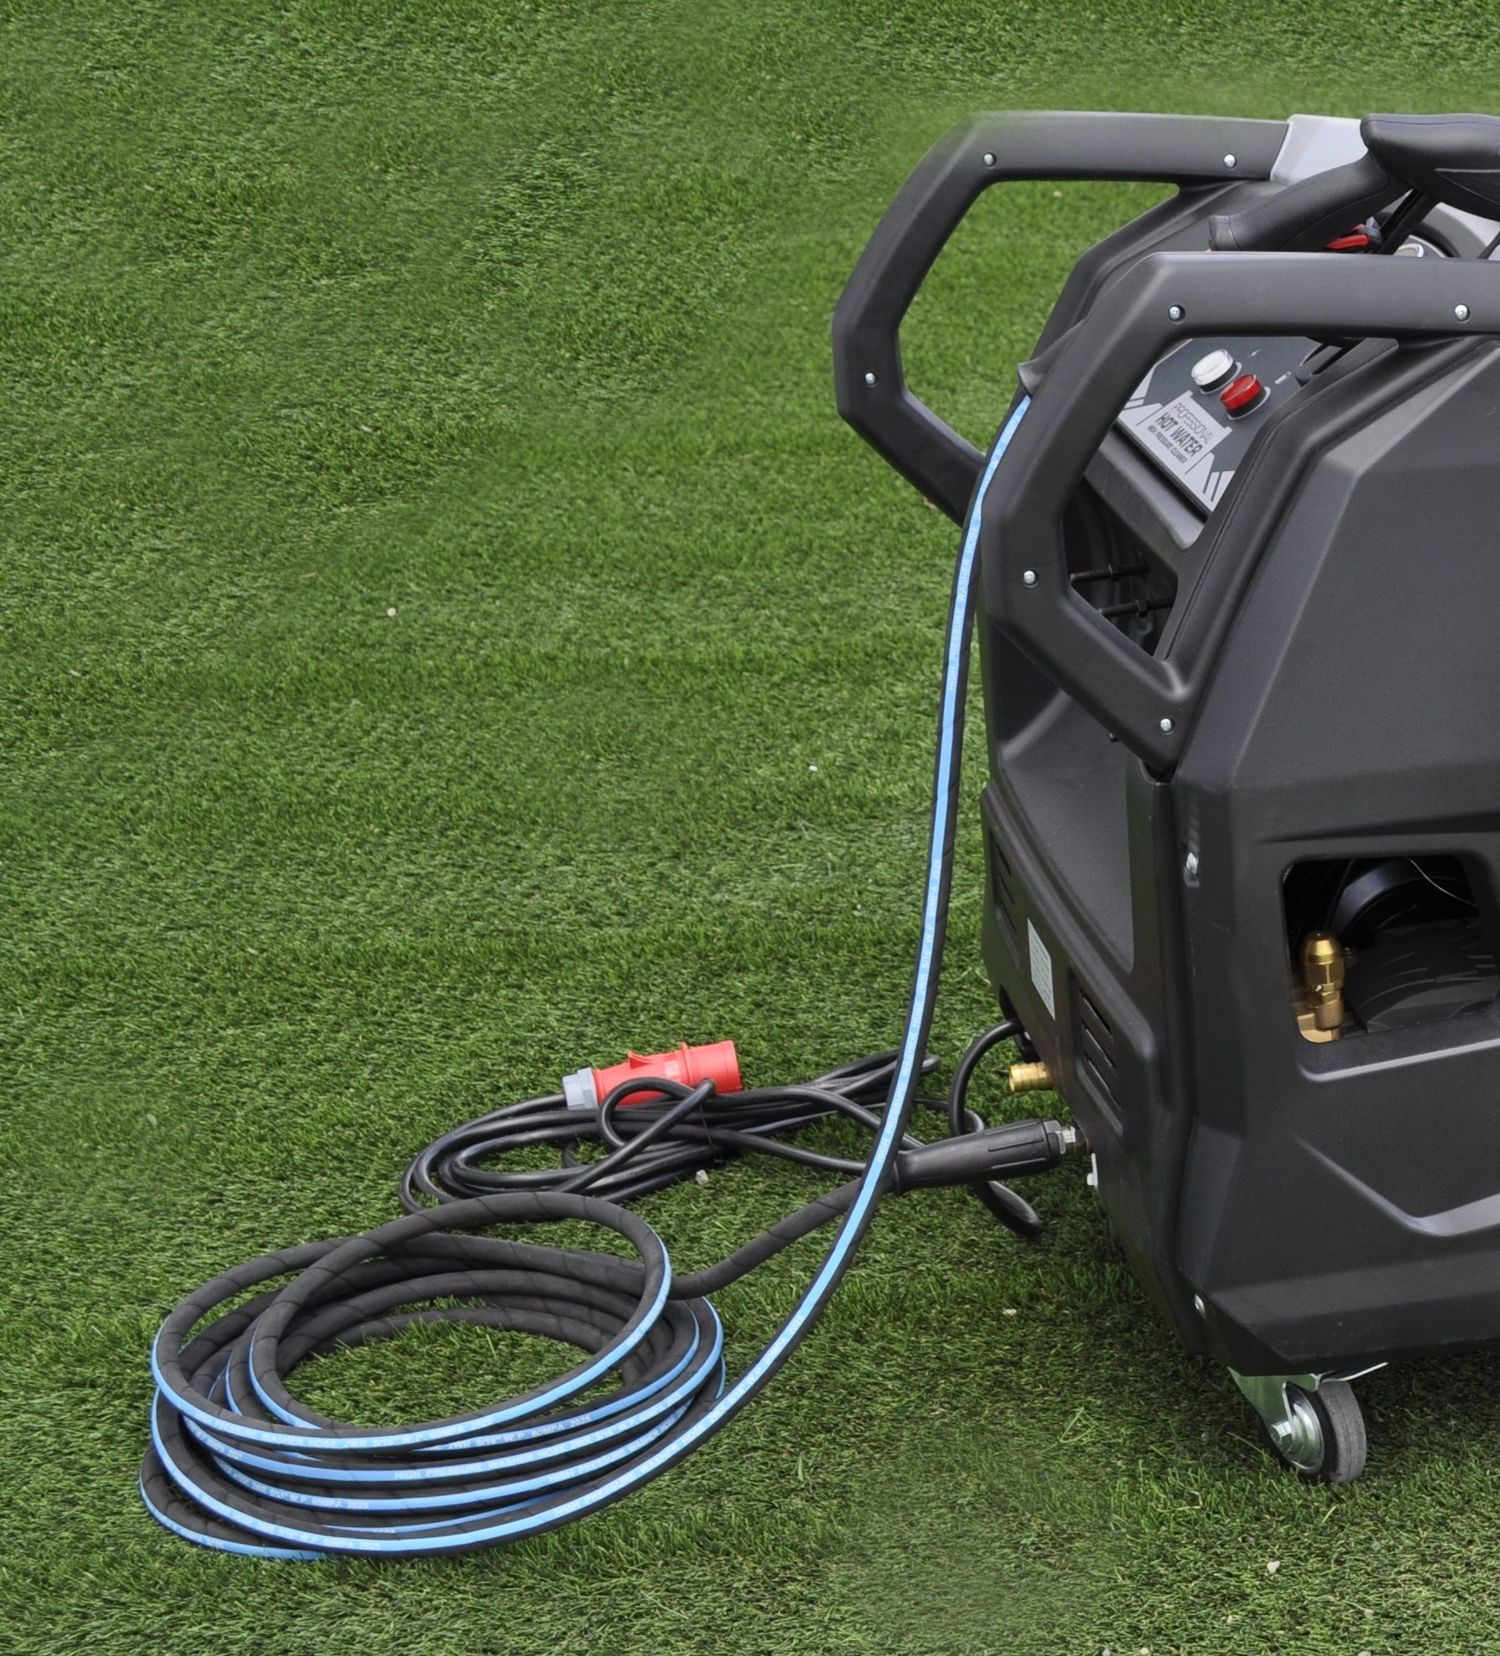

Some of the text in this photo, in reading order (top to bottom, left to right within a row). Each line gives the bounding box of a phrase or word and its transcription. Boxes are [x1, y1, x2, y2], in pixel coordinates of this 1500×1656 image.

[1155, 411, 1203, 457] HOT WATER
[1173, 402, 1214, 445] PROFESSIONAL
